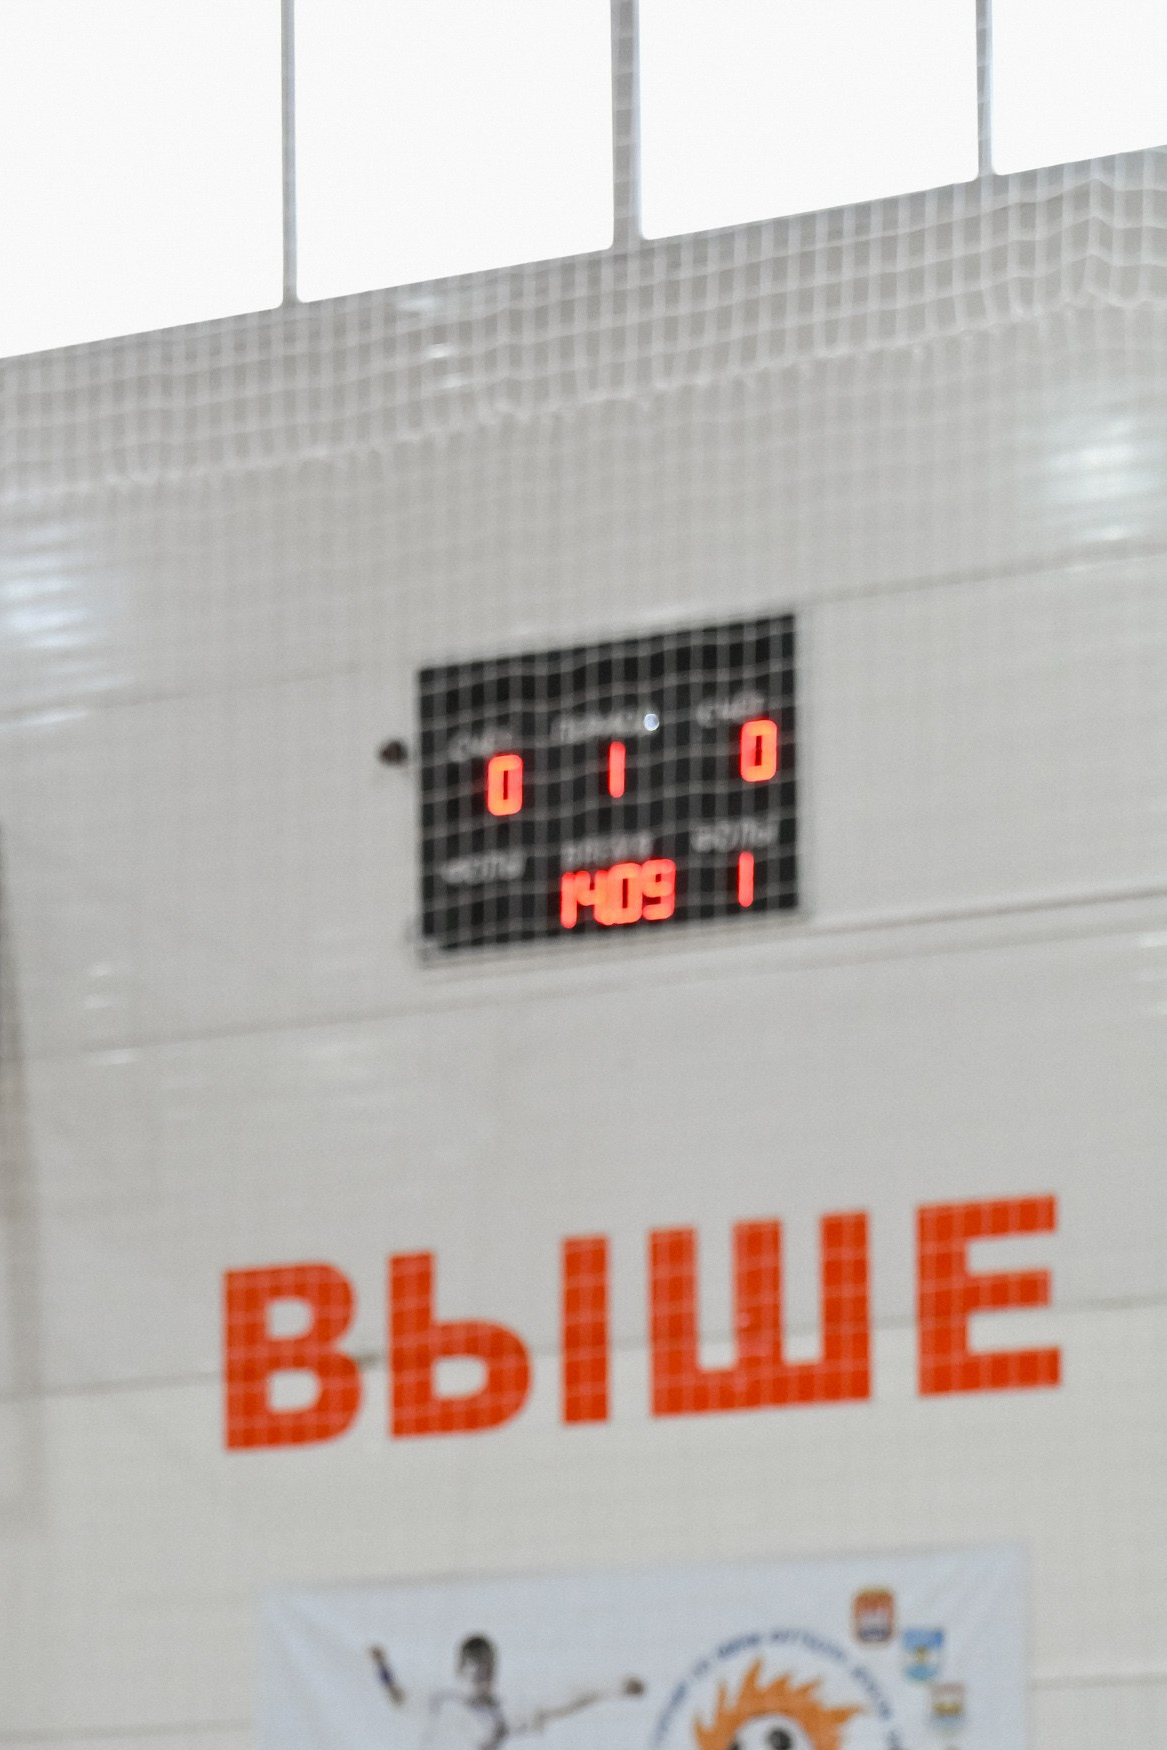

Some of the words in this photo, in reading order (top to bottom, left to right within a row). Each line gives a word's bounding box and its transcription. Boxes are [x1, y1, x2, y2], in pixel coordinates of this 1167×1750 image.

[487, 754, 524, 817] 0
[740, 720, 778, 783] 0
[224, 1195, 1063, 1452] ВЫШЕ
